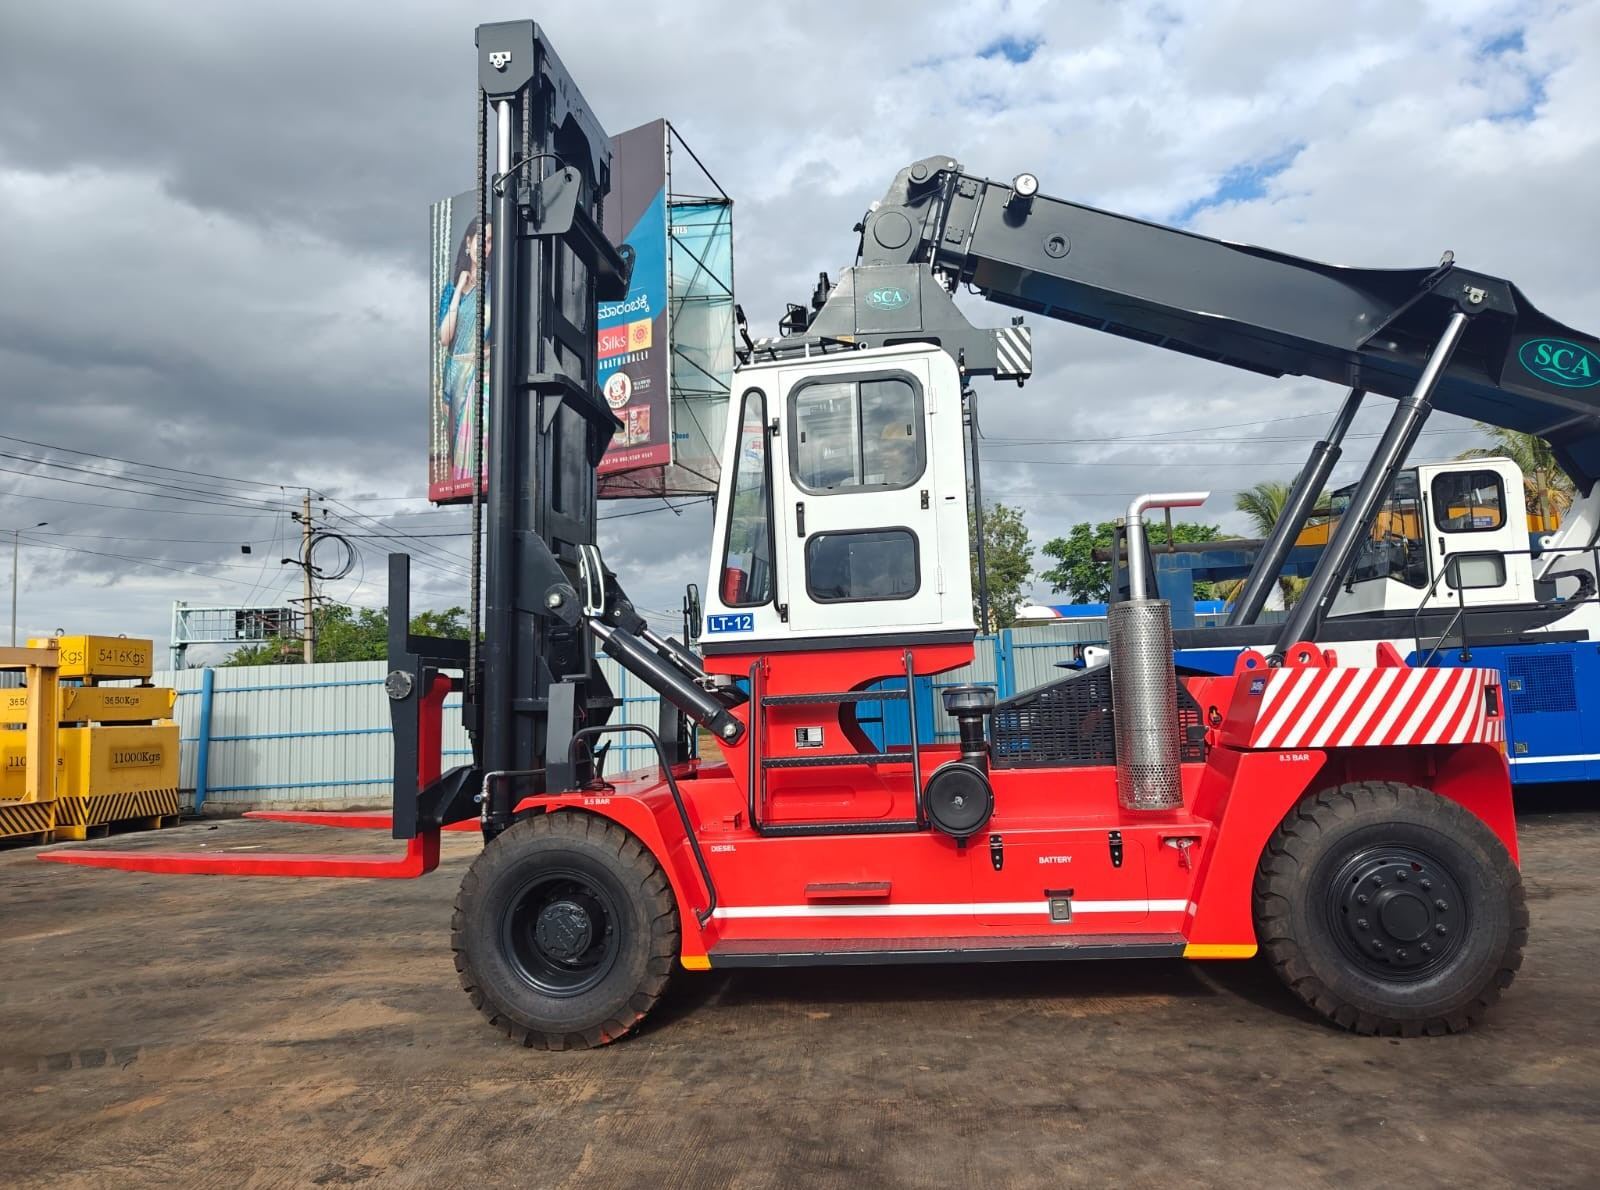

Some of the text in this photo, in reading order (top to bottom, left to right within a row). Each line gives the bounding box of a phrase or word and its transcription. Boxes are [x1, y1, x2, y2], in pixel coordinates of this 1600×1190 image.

[873, 291, 902, 302] SCA
[598, 294, 650, 320] ಮಾರಂಭಕ್ಕೆ
[599, 336, 626, 352] Silks
[599, 351, 649, 370] ARATHAHALLI
[1534, 343, 1592, 377] SCA
[711, 616, 751, 631] LT-12
[60, 649, 83, 665] Kgs
[98, 649, 145, 665] 5416Kgs
[104, 696, 139, 706] 3650Kgs
[113, 751, 161, 764] 11000Kgs
[711, 844, 737, 852] DIESEL
[1038, 855, 1073, 864] BATTERY
